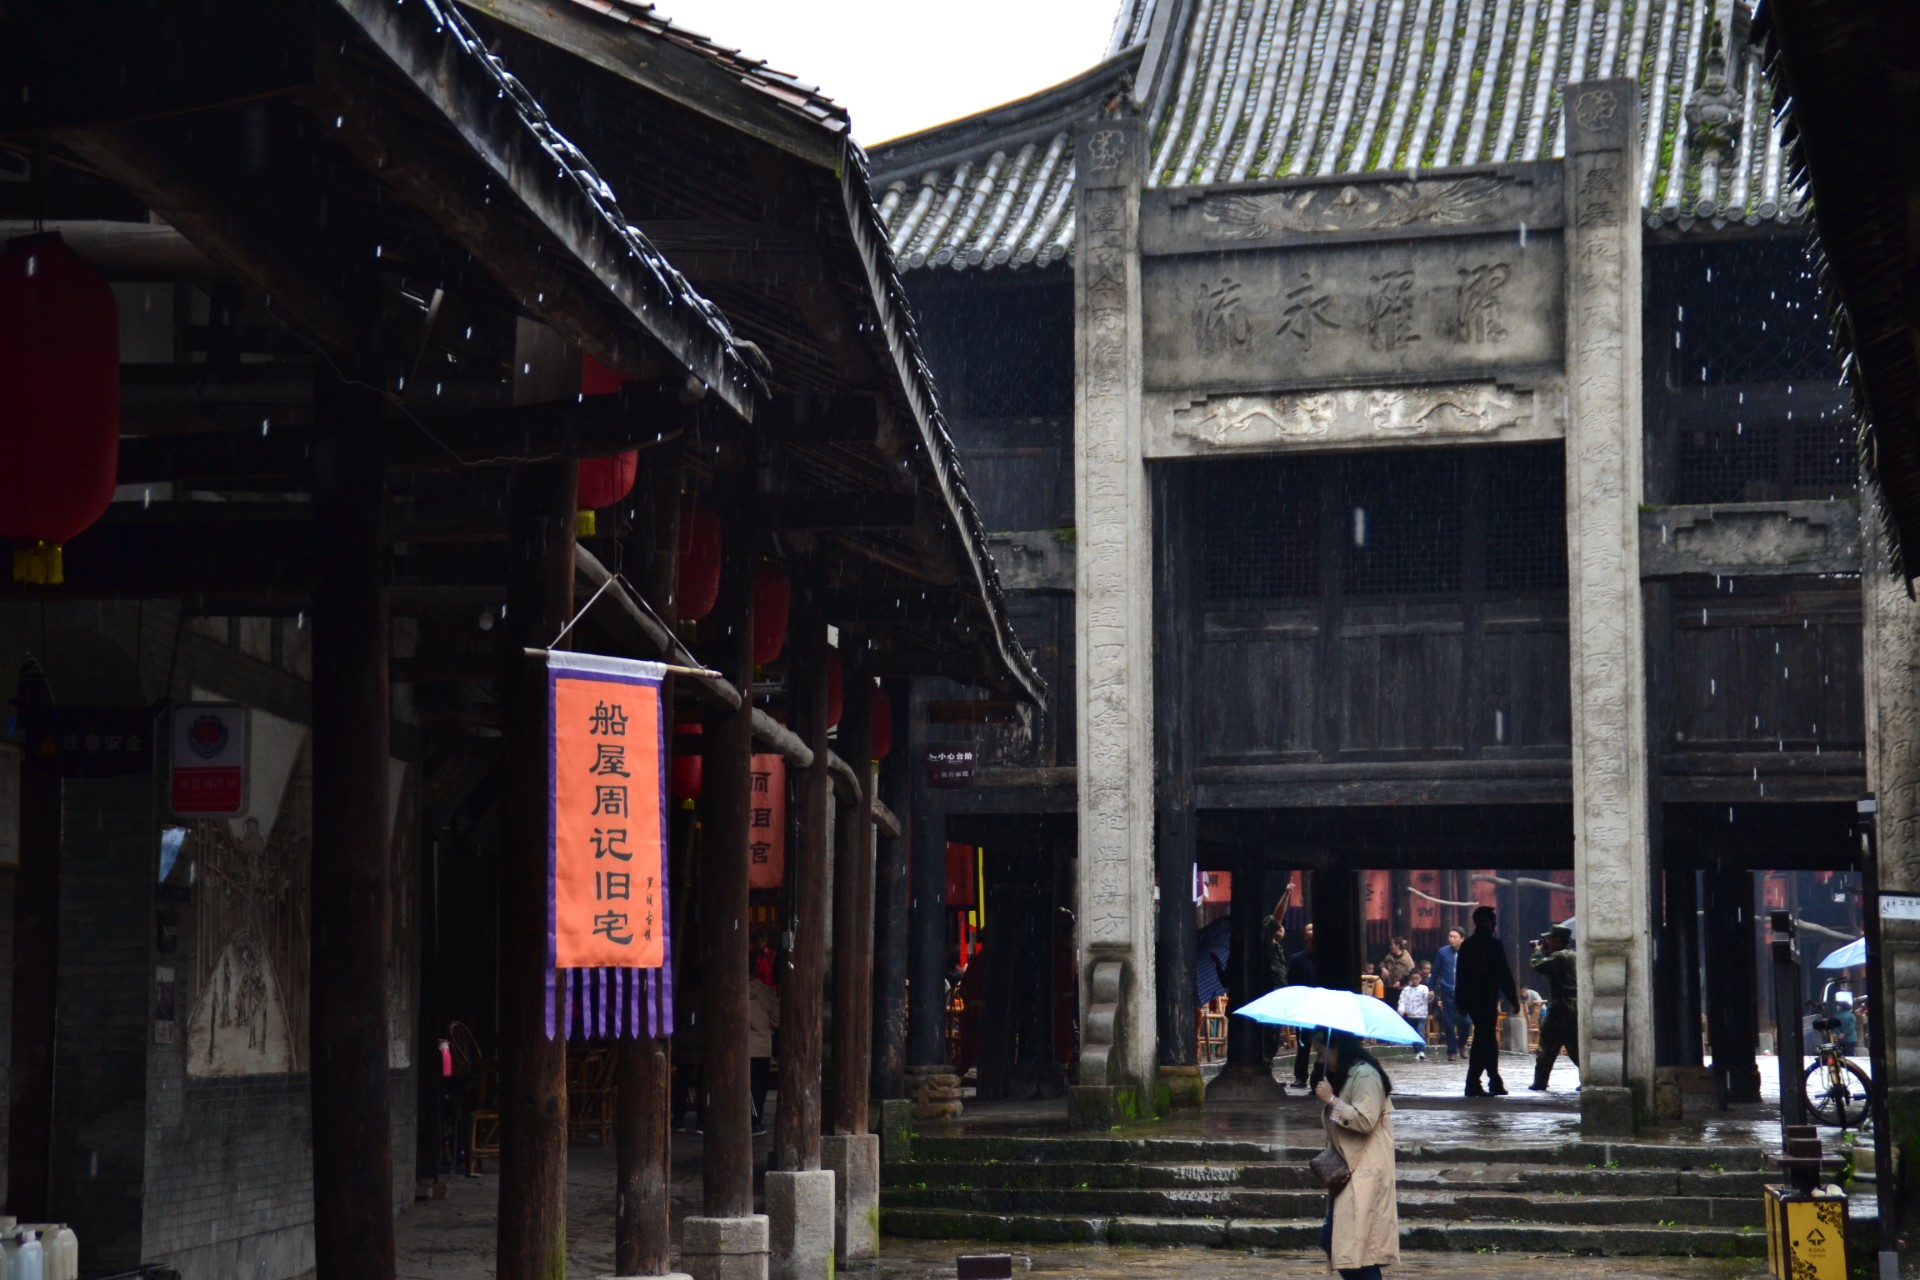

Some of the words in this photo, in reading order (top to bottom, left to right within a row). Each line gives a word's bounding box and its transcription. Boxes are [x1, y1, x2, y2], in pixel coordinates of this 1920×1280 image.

[62, 733, 145, 751] 注意安全
[938, 751, 973, 761] 小心台阶
[588, 699, 634, 945] 船屋周记旧宅
